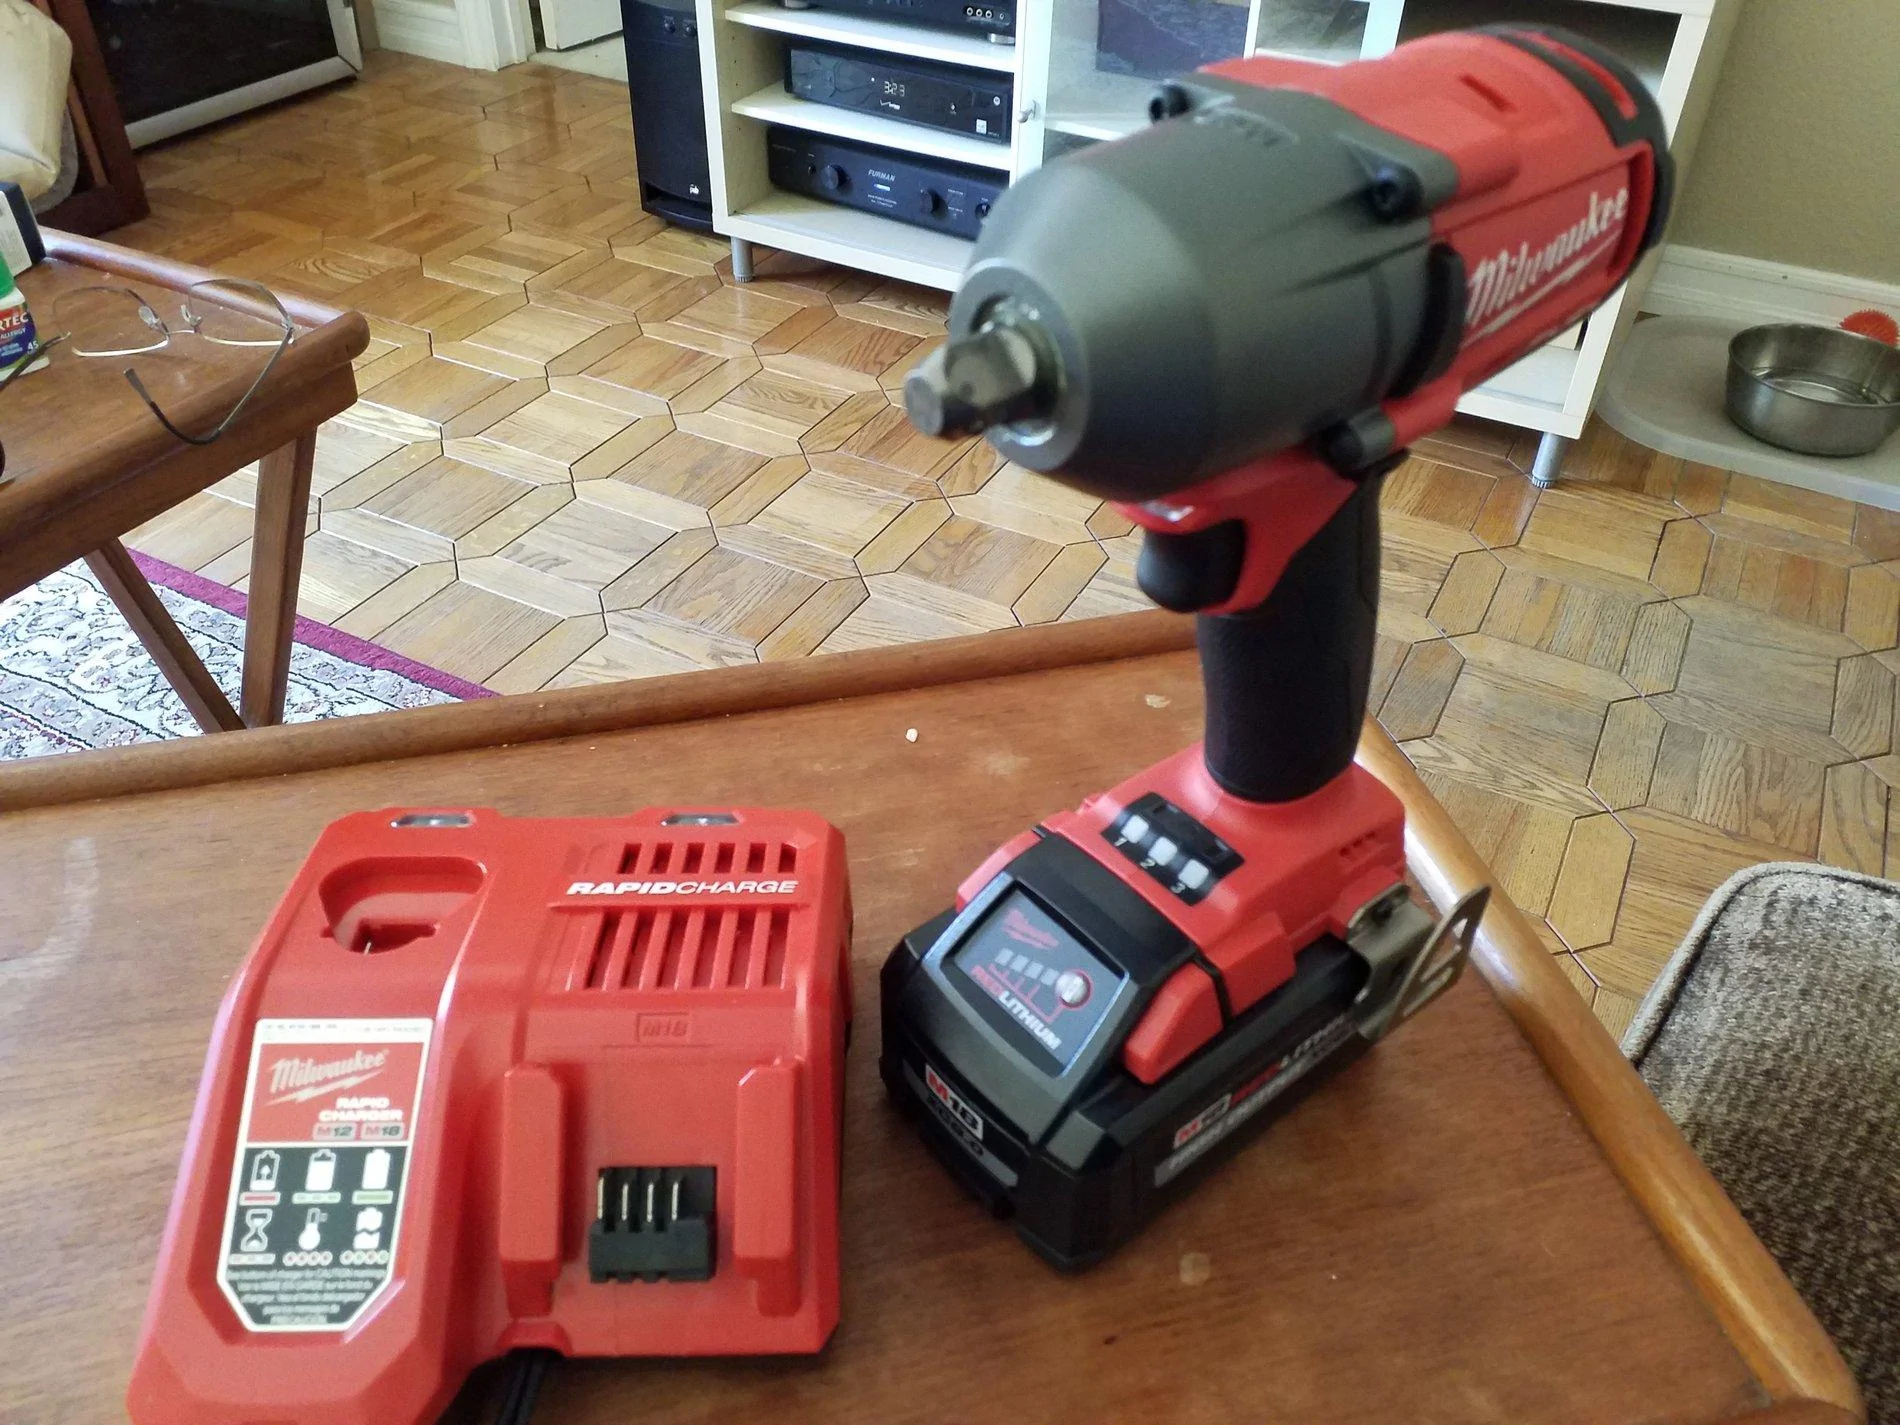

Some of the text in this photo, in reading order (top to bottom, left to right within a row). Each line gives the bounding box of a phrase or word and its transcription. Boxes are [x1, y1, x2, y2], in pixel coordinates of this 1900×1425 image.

[868, 169, 896, 182] FURMAN
[1140, 857, 1156, 869] 2
[566, 880, 798, 895] RAPIDCHARGE
[1170, 881, 1186, 894] 3
[266, 1049, 387, 1094] Milwaukee
[927, 1070, 980, 1131] M18
